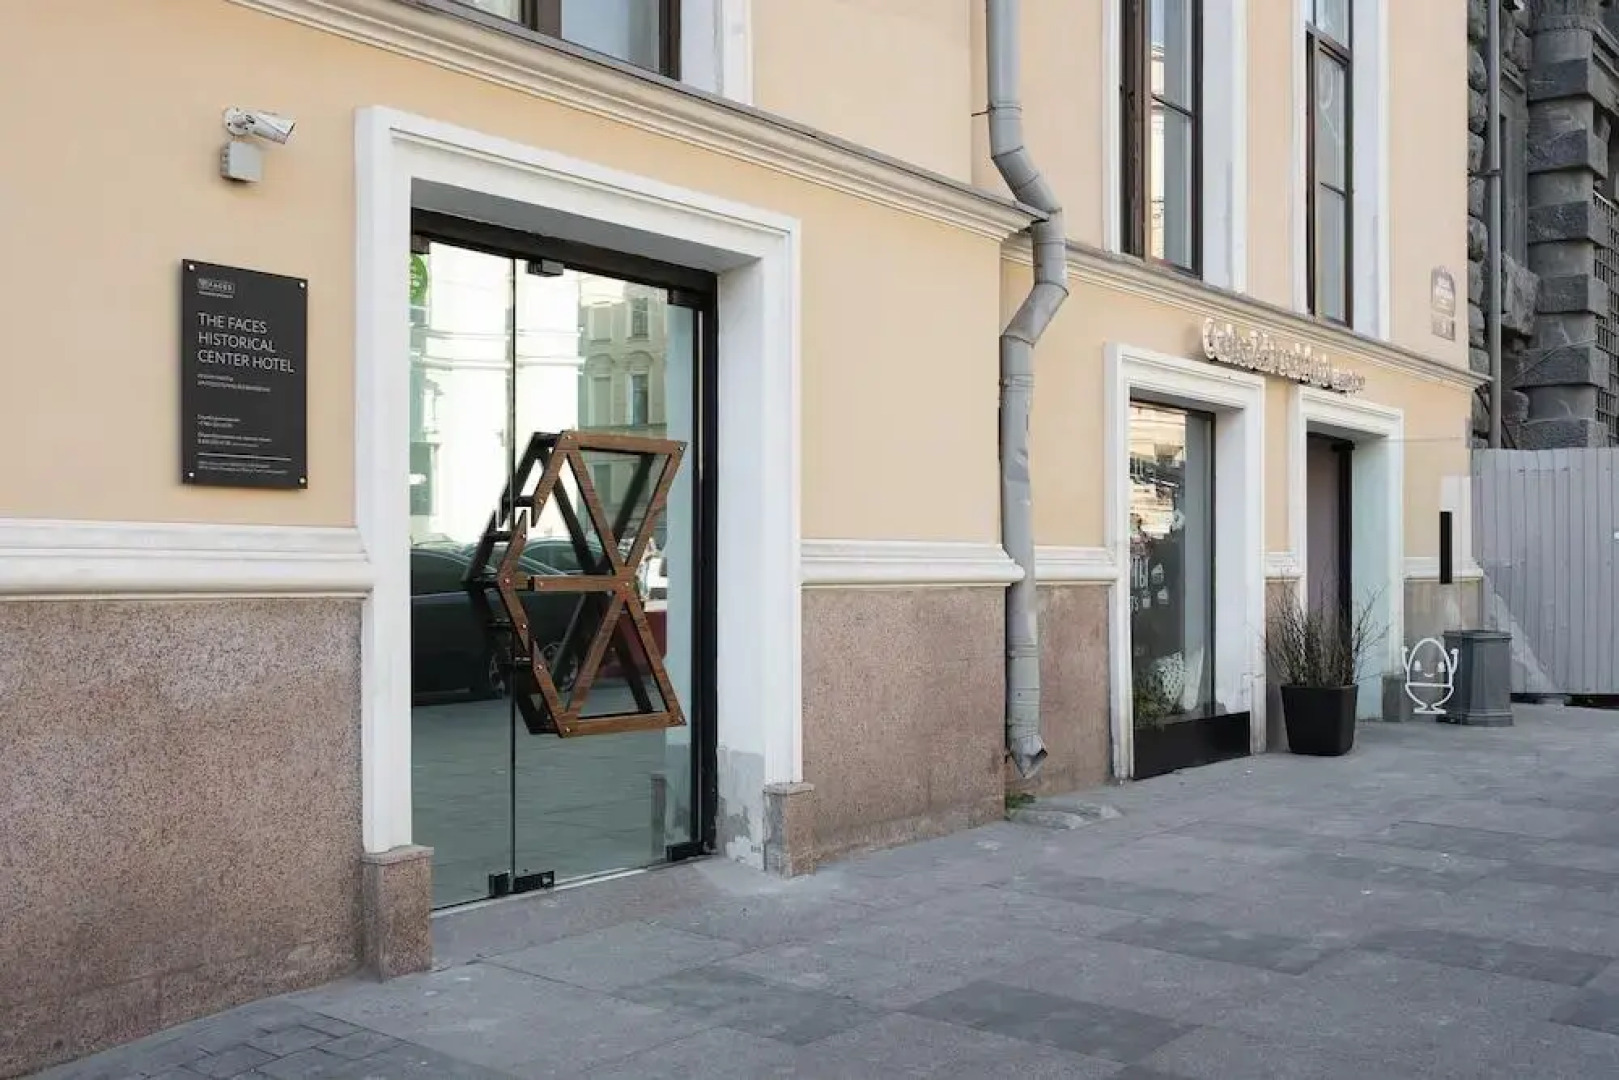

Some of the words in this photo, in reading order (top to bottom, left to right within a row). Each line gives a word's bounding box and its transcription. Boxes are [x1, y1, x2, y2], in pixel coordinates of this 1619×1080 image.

[198, 312, 225, 328] THE
[228, 317, 267, 334] FACES
[198, 331, 276, 353] HISTORICAL
[198, 349, 249, 367] CENTER
[253, 356, 295, 373] HOTEL
